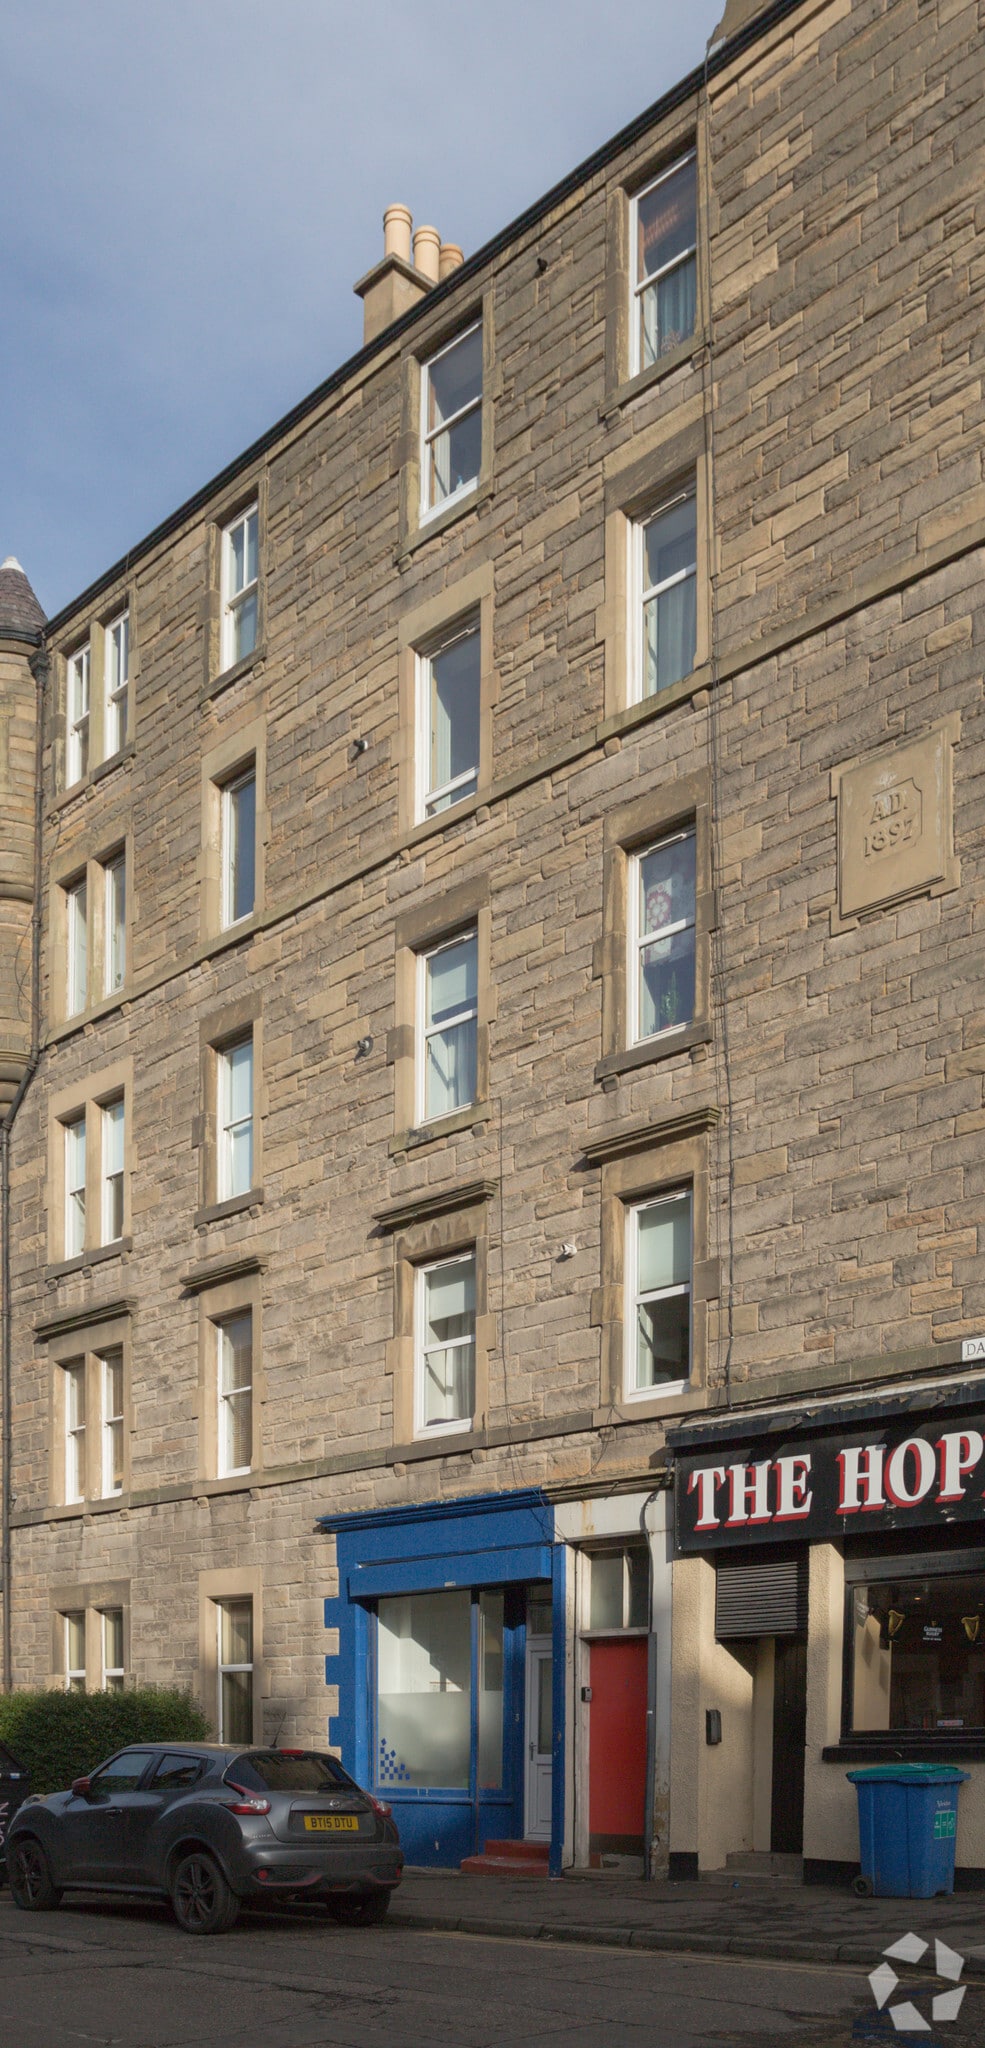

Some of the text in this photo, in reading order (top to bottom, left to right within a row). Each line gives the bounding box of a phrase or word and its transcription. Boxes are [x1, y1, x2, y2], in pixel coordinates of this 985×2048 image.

[864, 818, 914, 857] 1897
[687, 1430, 985, 1531] THE HOP
[310, 1817, 353, 1828] BT15 DTU
